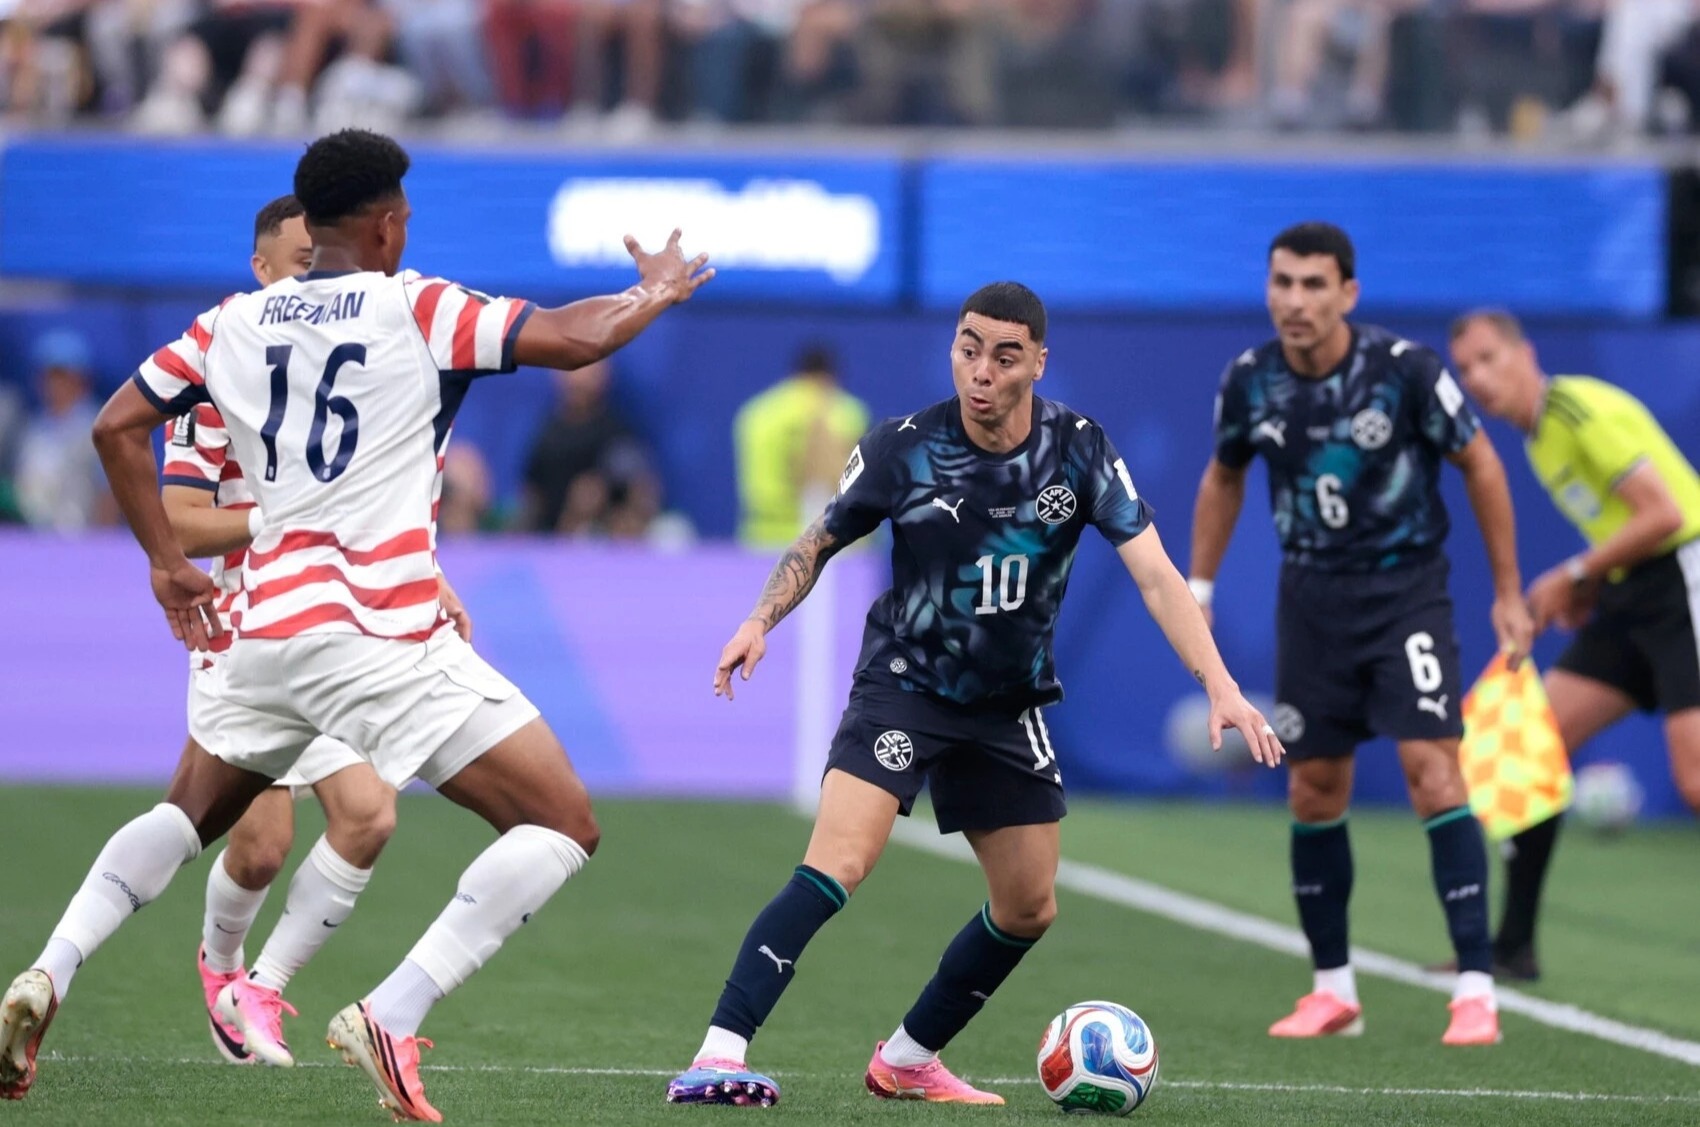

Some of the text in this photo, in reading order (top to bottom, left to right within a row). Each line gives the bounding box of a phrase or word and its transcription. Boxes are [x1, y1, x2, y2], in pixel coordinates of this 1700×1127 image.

[260, 342, 367, 483] 16
[1315, 473, 1349, 529] 6
[975, 553, 1029, 615] 10
[1404, 631, 1443, 693] 6
